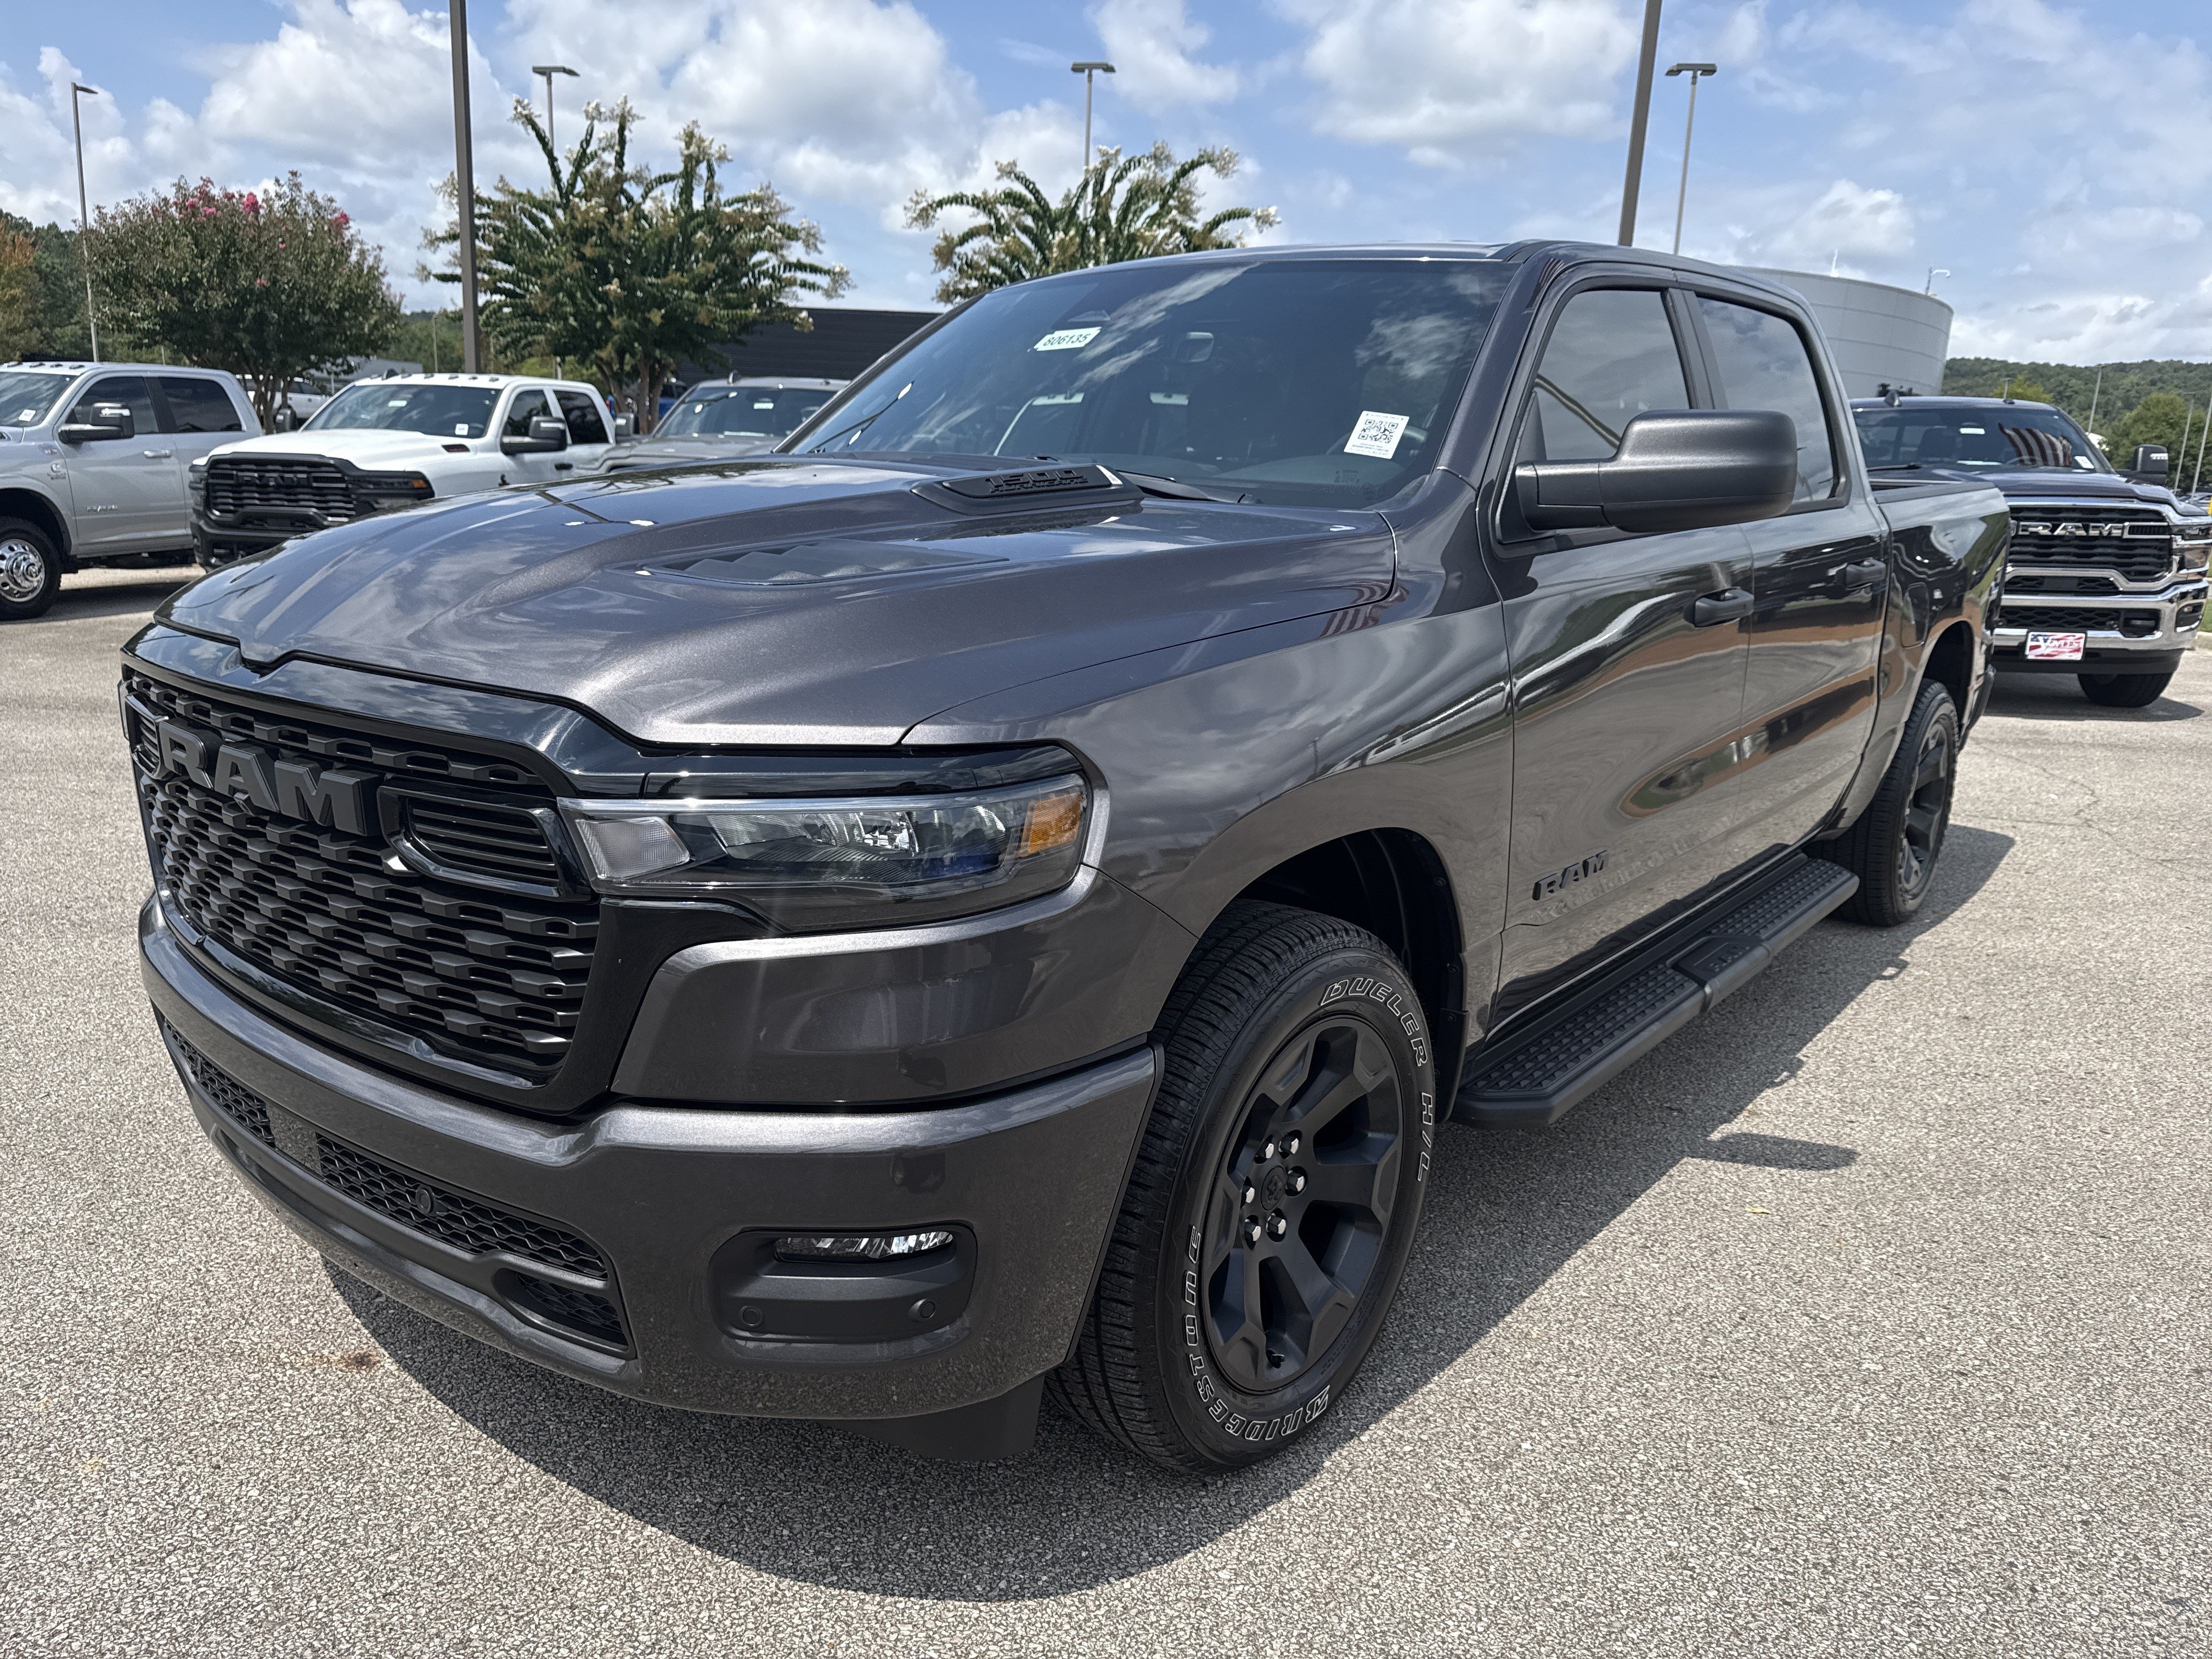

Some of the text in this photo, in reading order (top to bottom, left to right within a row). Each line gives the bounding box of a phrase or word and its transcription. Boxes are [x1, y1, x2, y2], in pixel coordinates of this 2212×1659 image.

[1043, 334, 1091, 346] 806135
[237, 471, 307, 486] RAM
[985, 469, 1083, 488] 1500
[2018, 522, 2123, 537] RAM
[159, 719, 380, 836] RAM
[1532, 850, 1610, 900] RAM
[1319, 977, 1428, 1067] DUELER
[1417, 1092, 1433, 1182] H/L
[1185, 1225, 1330, 1442] BRIDGESTONE
